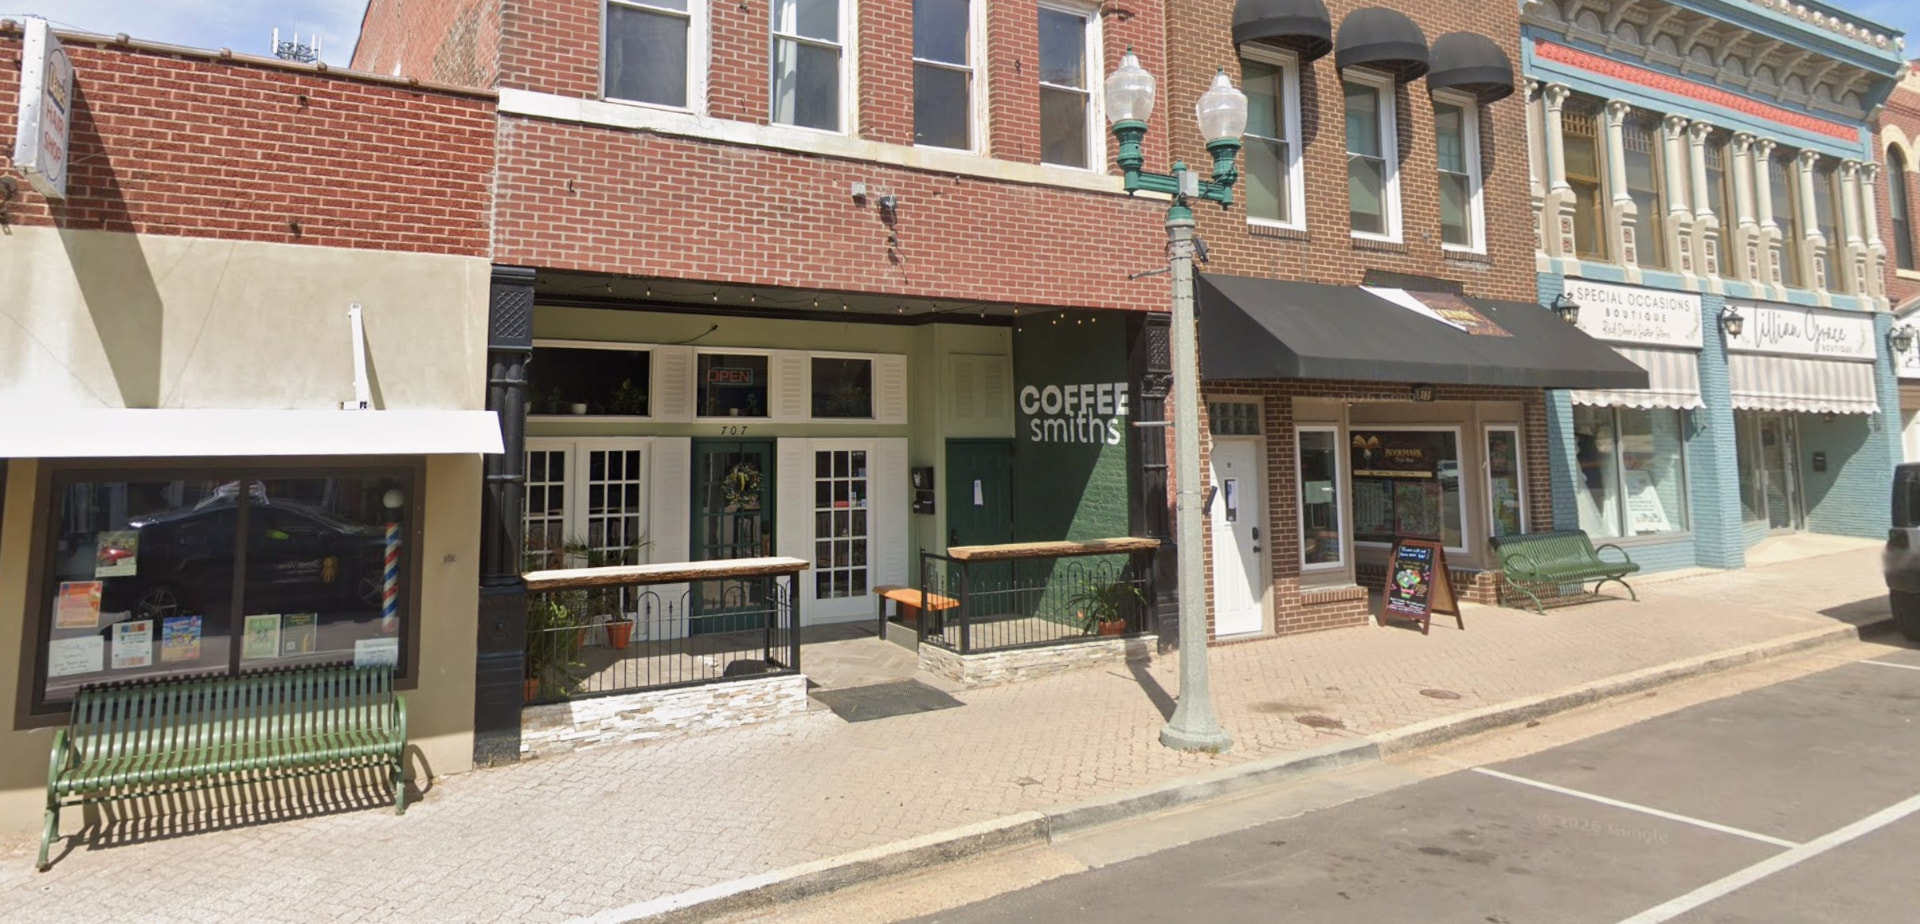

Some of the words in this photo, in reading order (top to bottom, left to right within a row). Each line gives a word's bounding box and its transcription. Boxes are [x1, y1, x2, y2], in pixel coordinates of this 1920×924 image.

[1577, 288, 1622, 304] SPECIAL
[1628, 293, 1690, 312] OCCASIONS
[1606, 308, 1666, 322] BOUTIQUE
[1804, 309, 1846, 352] Grace
[707, 369, 750, 383] OPEN
[1020, 382, 1129, 415] COFFEE
[721, 425, 748, 435] 707
[1030, 407, 1121, 445] smiths
